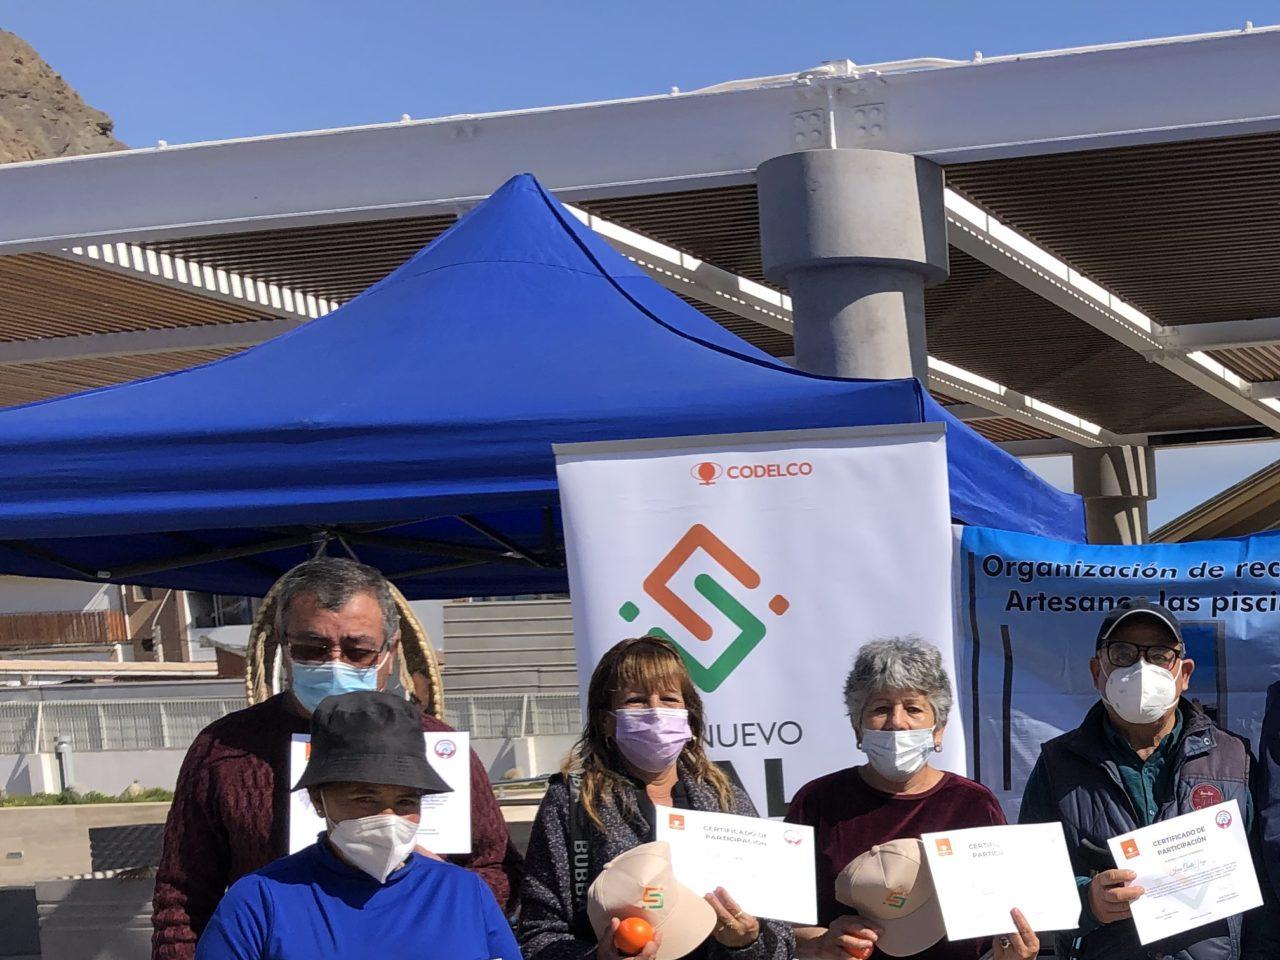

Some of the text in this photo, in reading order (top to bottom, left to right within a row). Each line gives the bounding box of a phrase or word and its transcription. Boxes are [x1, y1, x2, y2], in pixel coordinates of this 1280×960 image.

[727, 462, 812, 479] CODELCO
[982, 554, 1178, 583] Organización
[1188, 562, 1224, 578] de
[1159, 590, 1200, 612] las
[1152, 825, 1206, 848] CERTIFICADO DE
[1157, 834, 1207, 857] PARTICIPACIÓN
